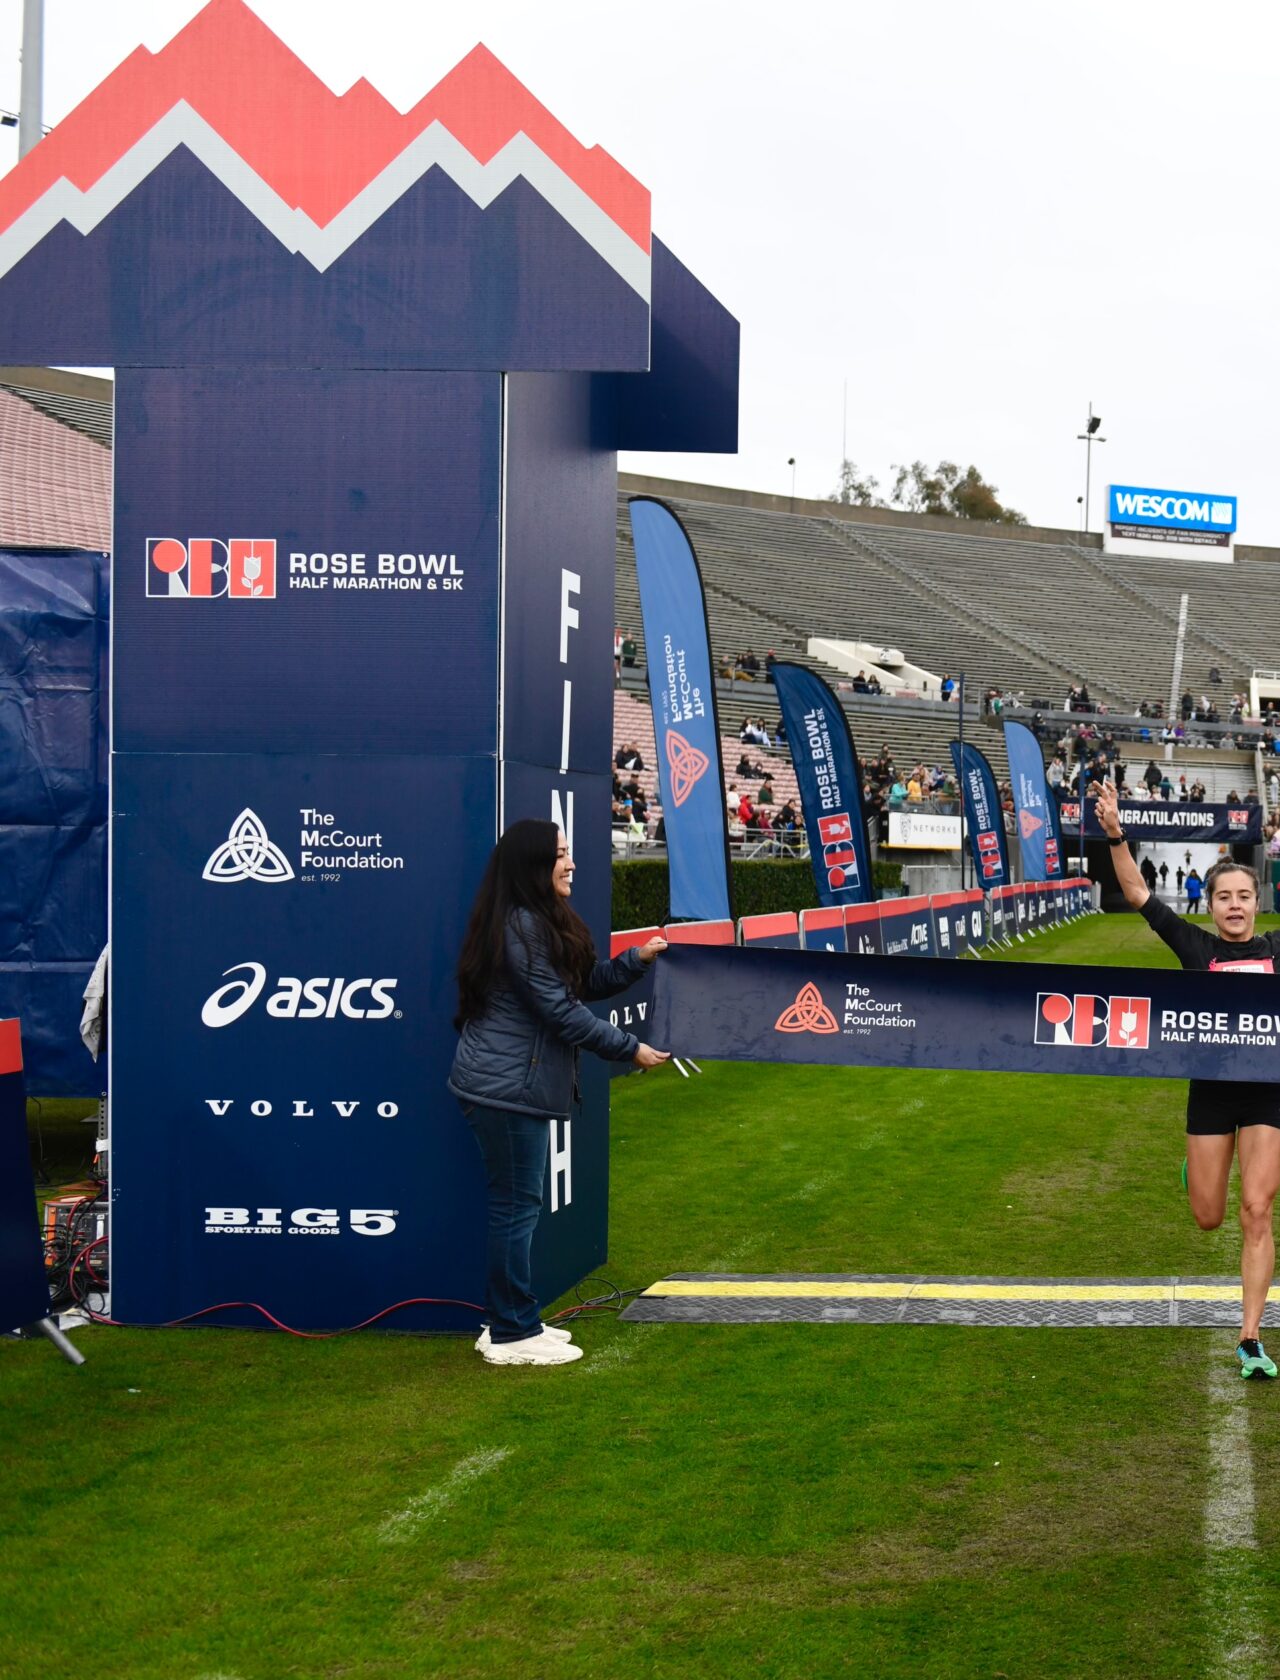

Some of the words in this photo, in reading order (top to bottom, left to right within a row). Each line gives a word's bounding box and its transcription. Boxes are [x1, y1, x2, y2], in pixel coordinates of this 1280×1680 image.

[1115, 492, 1210, 522] WESCOM
[289, 552, 366, 575] ROSE
[378, 553, 464, 576] BOWL
[289, 576, 329, 589] HALF
[333, 577, 425, 590] MARATHON
[427, 578, 438, 590] &
[443, 578, 464, 591] 5K
[804, 708, 825, 761] BOWL
[822, 731, 838, 785] MARATHON
[815, 764, 834, 810] ROSE
[968, 768, 981, 800] BOWL
[833, 785, 842, 807] HALF
[300, 808, 335, 826] The
[976, 801, 987, 831] ROSE
[1118, 810, 1214, 827] NGRATULATIONS
[913, 824, 957, 834] NETWORKS
[300, 830, 383, 848] McCourt
[300, 851, 404, 869] Foundation
[301, 874, 317, 883] est.
[320, 873, 341, 883] 1992
[551, 568, 581, 1214] FINH
[845, 984, 870, 996] The
[845, 998, 902, 1013] McCourt
[610, 1002, 647, 1028] OLV
[844, 1013, 916, 1028] Foundation
[1161, 1010, 1229, 1032] ROSE
[856, 1028, 872, 1036] 1992
[1160, 1030, 1195, 1042] HALF
[1198, 1032, 1277, 1046] MARATHON
[205, 1100, 399, 1118] VOLVO
[205, 1207, 341, 1227] BIG
[350, 1209, 397, 1236] 5
[205, 1226, 282, 1234] SPORTING
[288, 1227, 340, 1235] GOODS
